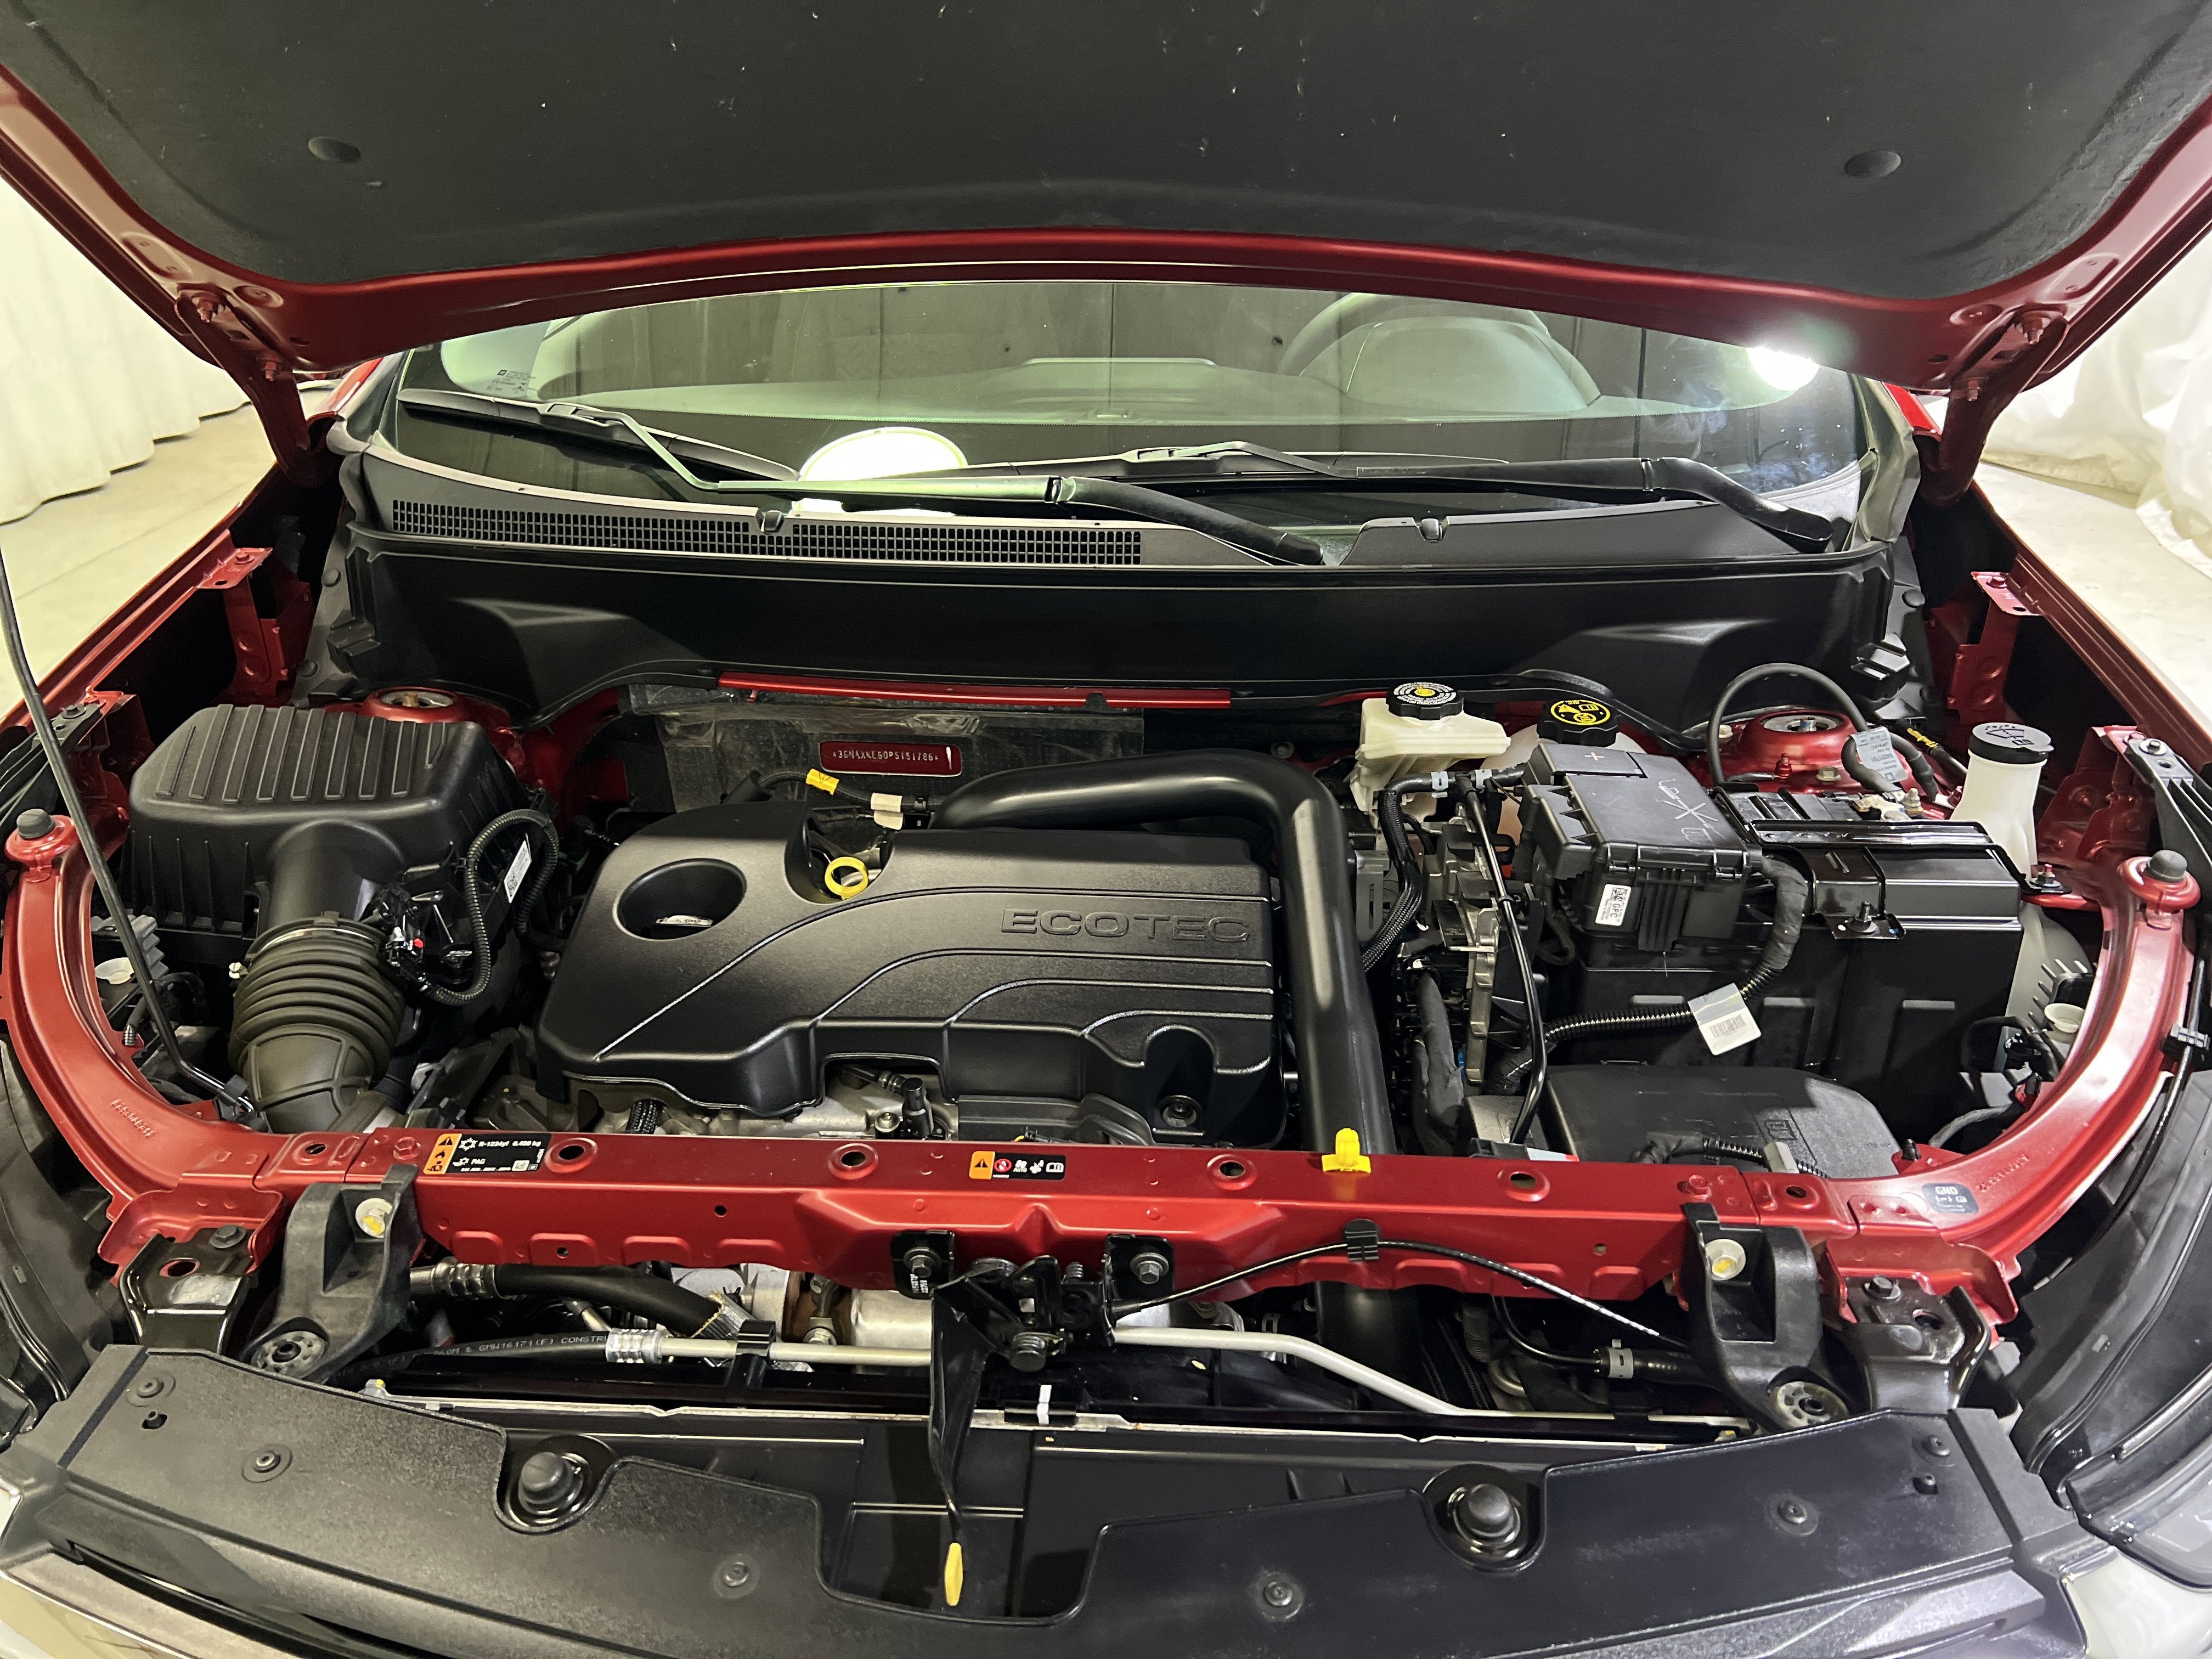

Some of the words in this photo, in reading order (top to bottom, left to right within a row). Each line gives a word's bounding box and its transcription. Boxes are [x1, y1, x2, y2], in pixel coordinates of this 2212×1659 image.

[1610, 903, 1620, 918] GPC
[1001, 909, 1250, 943] ECOTEC
[1935, 1186, 1959, 1195] GND
